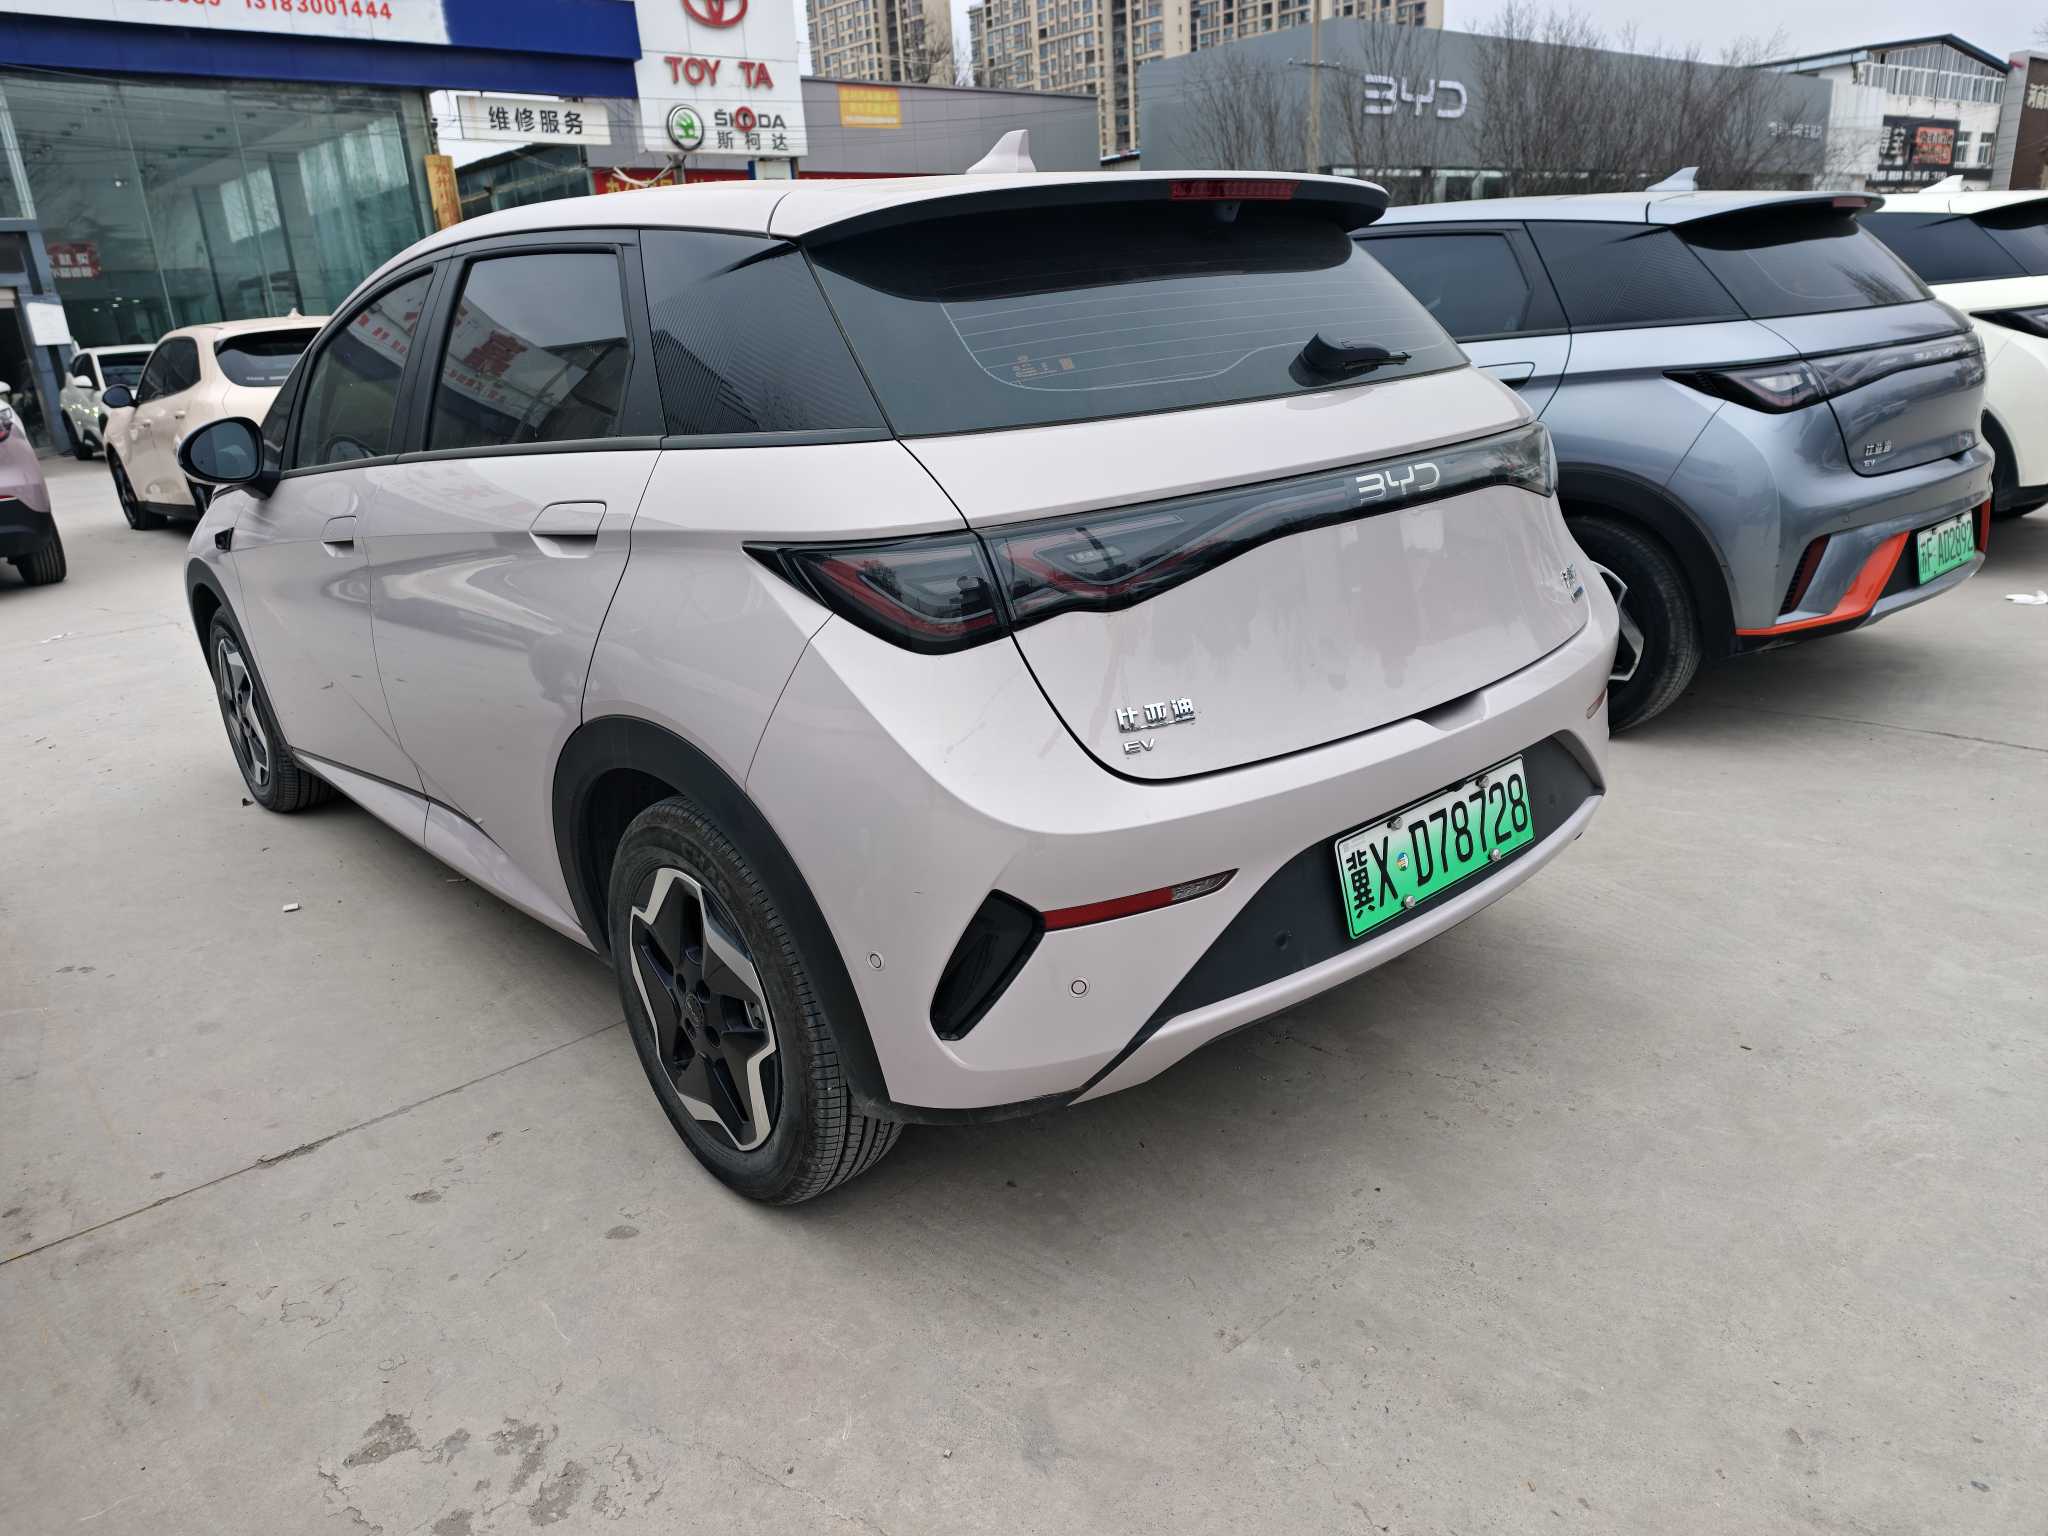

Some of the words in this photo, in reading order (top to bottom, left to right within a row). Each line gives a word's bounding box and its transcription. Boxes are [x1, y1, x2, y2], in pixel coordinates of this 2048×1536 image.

[664, 56, 721, 87] TOY
[738, 61, 774, 91] TA
[1364, 73, 1468, 119] BYD
[488, 105, 584, 135] 维修服务
[717, 130, 789, 151] 斯柯达
[1356, 462, 1441, 505] BYD
[1116, 697, 1196, 733] 比亚迪
[1123, 737, 1155, 755] EV
